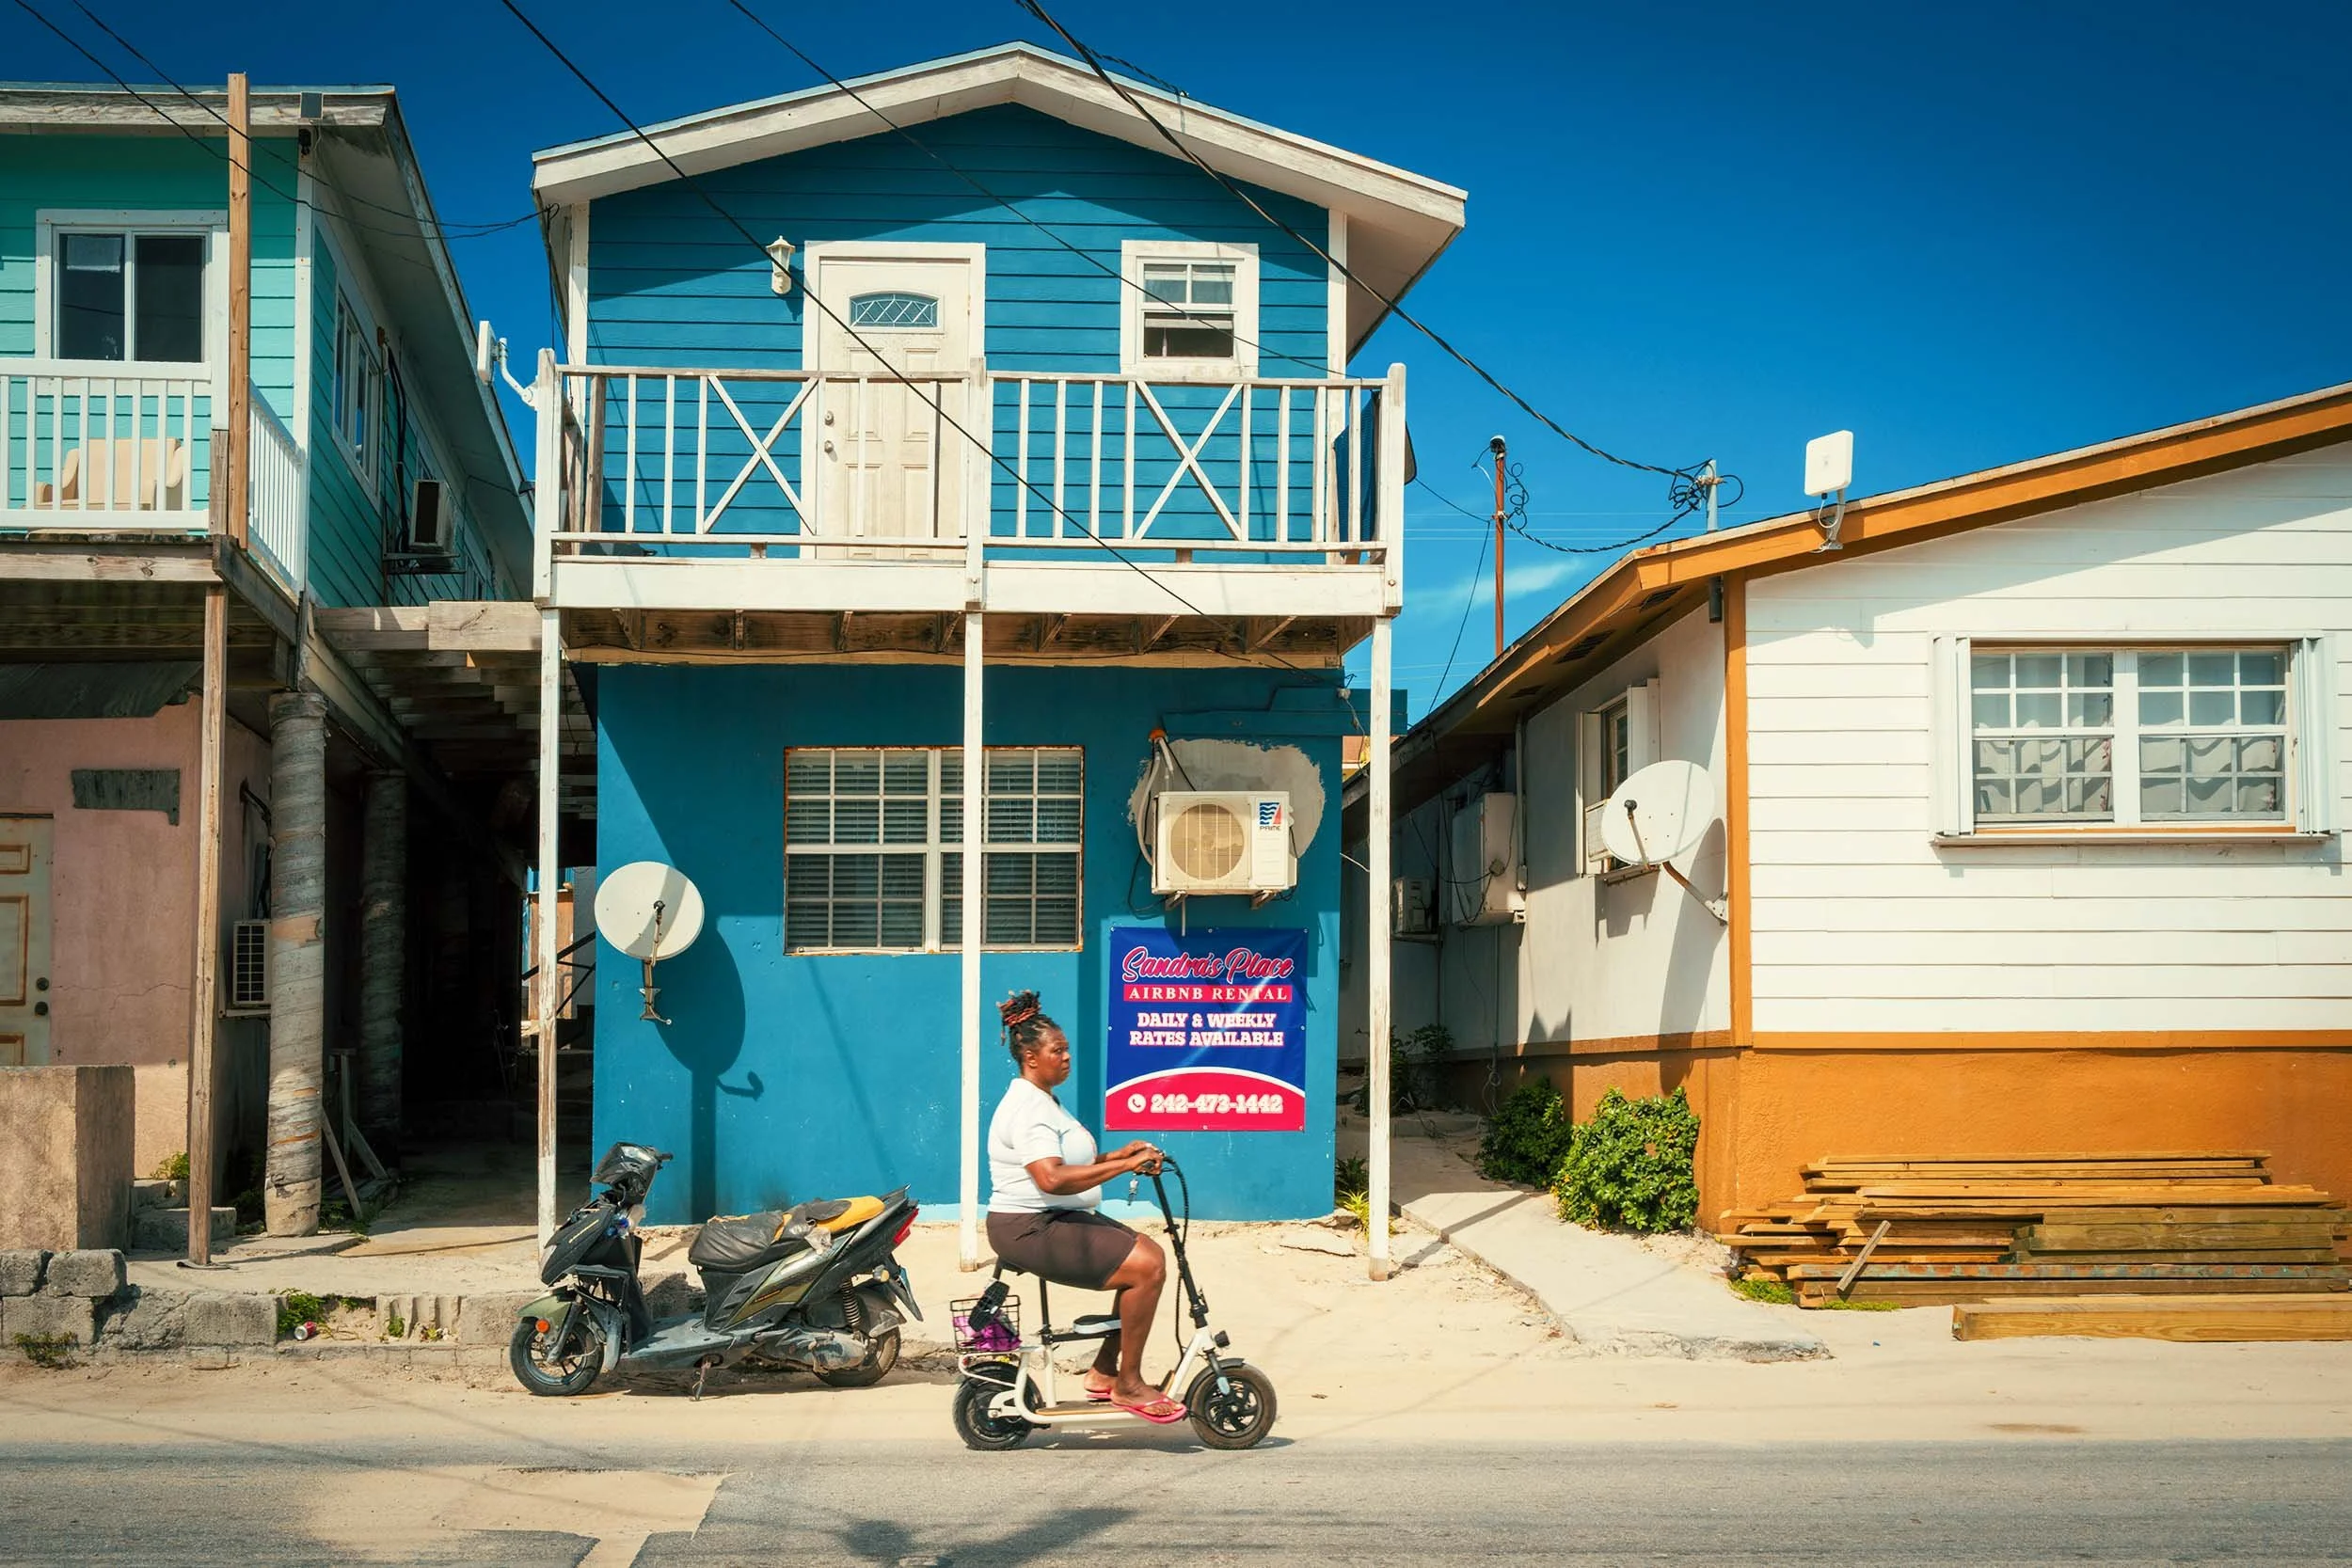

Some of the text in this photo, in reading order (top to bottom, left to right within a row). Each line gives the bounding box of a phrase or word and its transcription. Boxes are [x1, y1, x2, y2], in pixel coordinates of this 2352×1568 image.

[1122, 946, 1295, 984] Sandra's Place
[1129, 988, 1287, 1000] AIRBNB RENTAL
[1137, 1013, 1277, 1028] DAILY & WEEKLY
[1129, 1031, 1284, 1047] RATES AVAILABLE
[1151, 1094, 1283, 1114] 242-473-1442
